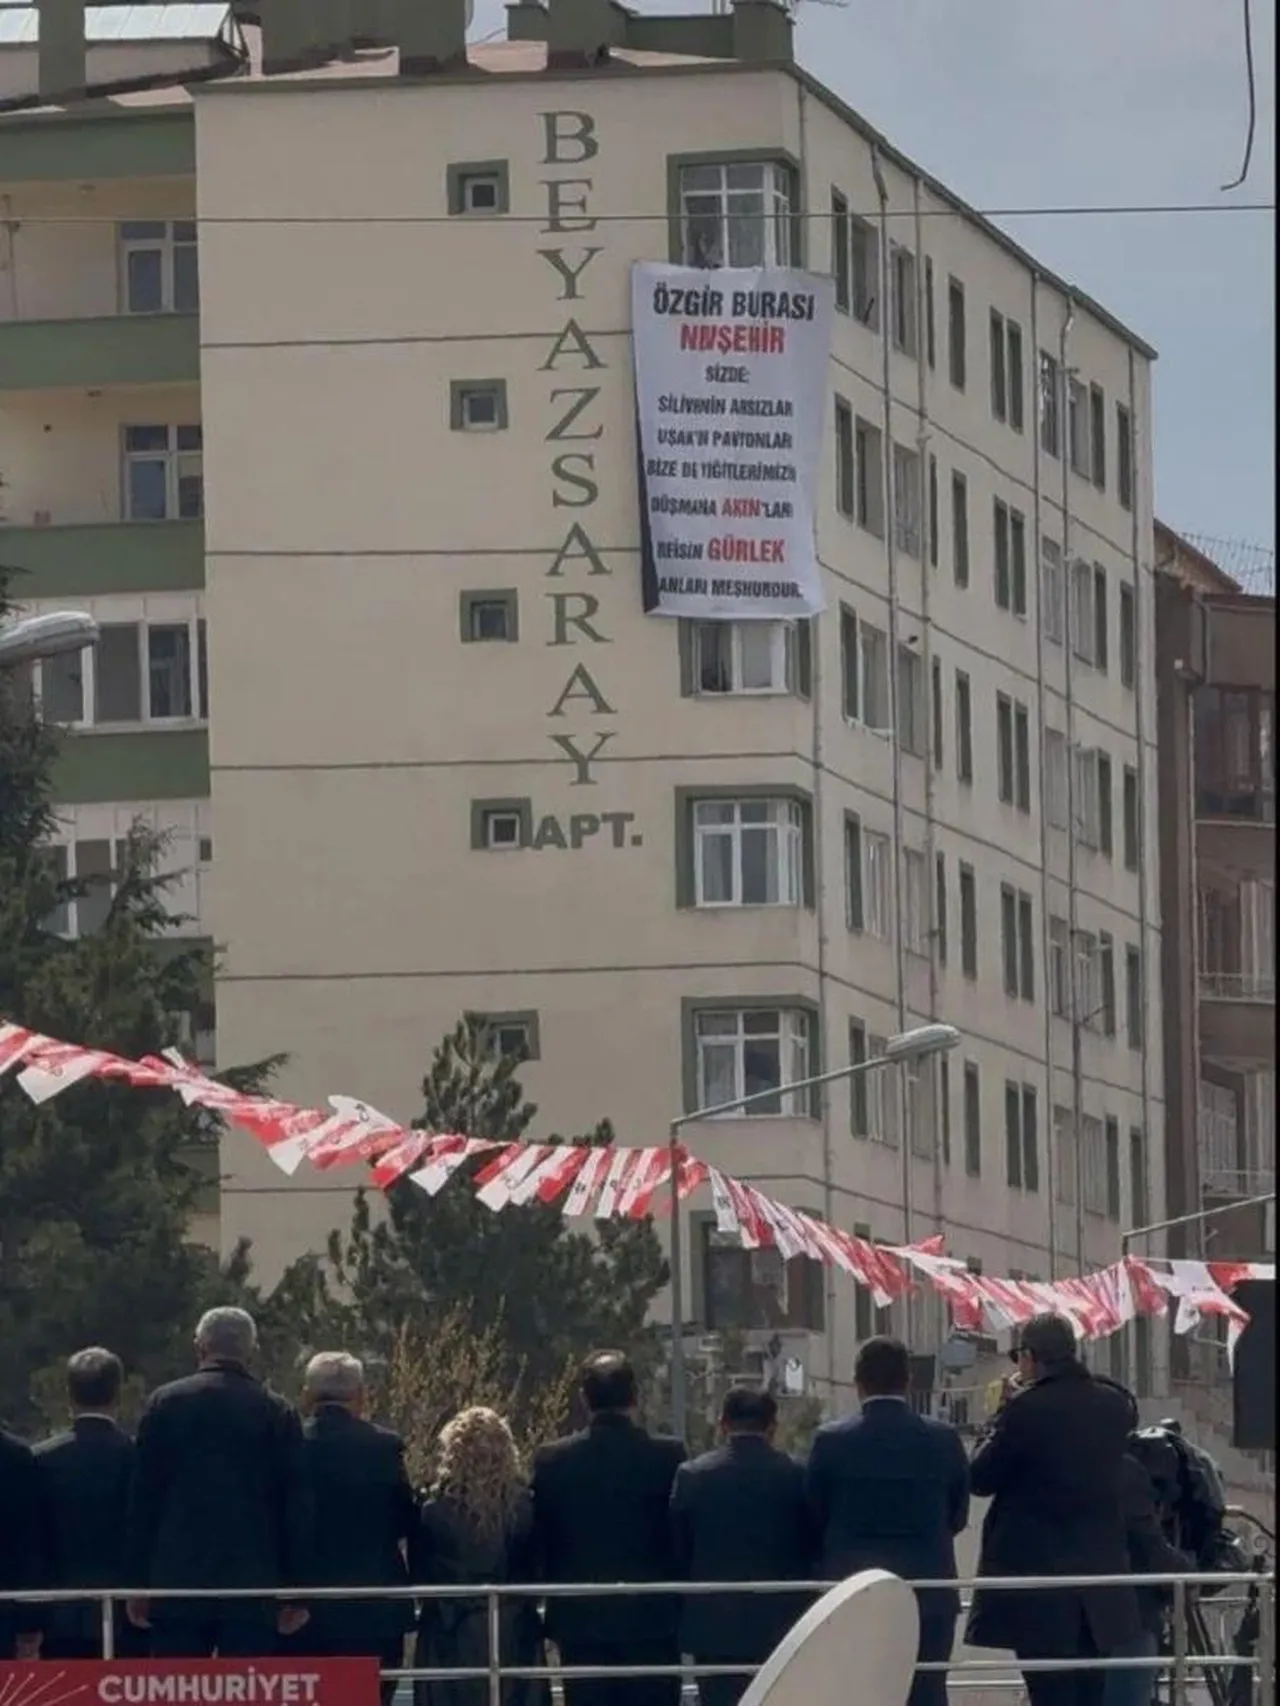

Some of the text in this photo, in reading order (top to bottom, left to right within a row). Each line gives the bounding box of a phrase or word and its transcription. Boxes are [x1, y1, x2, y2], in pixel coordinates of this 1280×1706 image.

[653, 281, 815, 321] ÖZGİR BURASI
[537, 110, 616, 786] BEYAZSARAY
[646, 456, 677, 477] BİZE
[708, 533, 785, 563] GÜRLEK
[530, 812, 643, 849] APT.
[98, 1666, 321, 1702] CUMHURİYET
